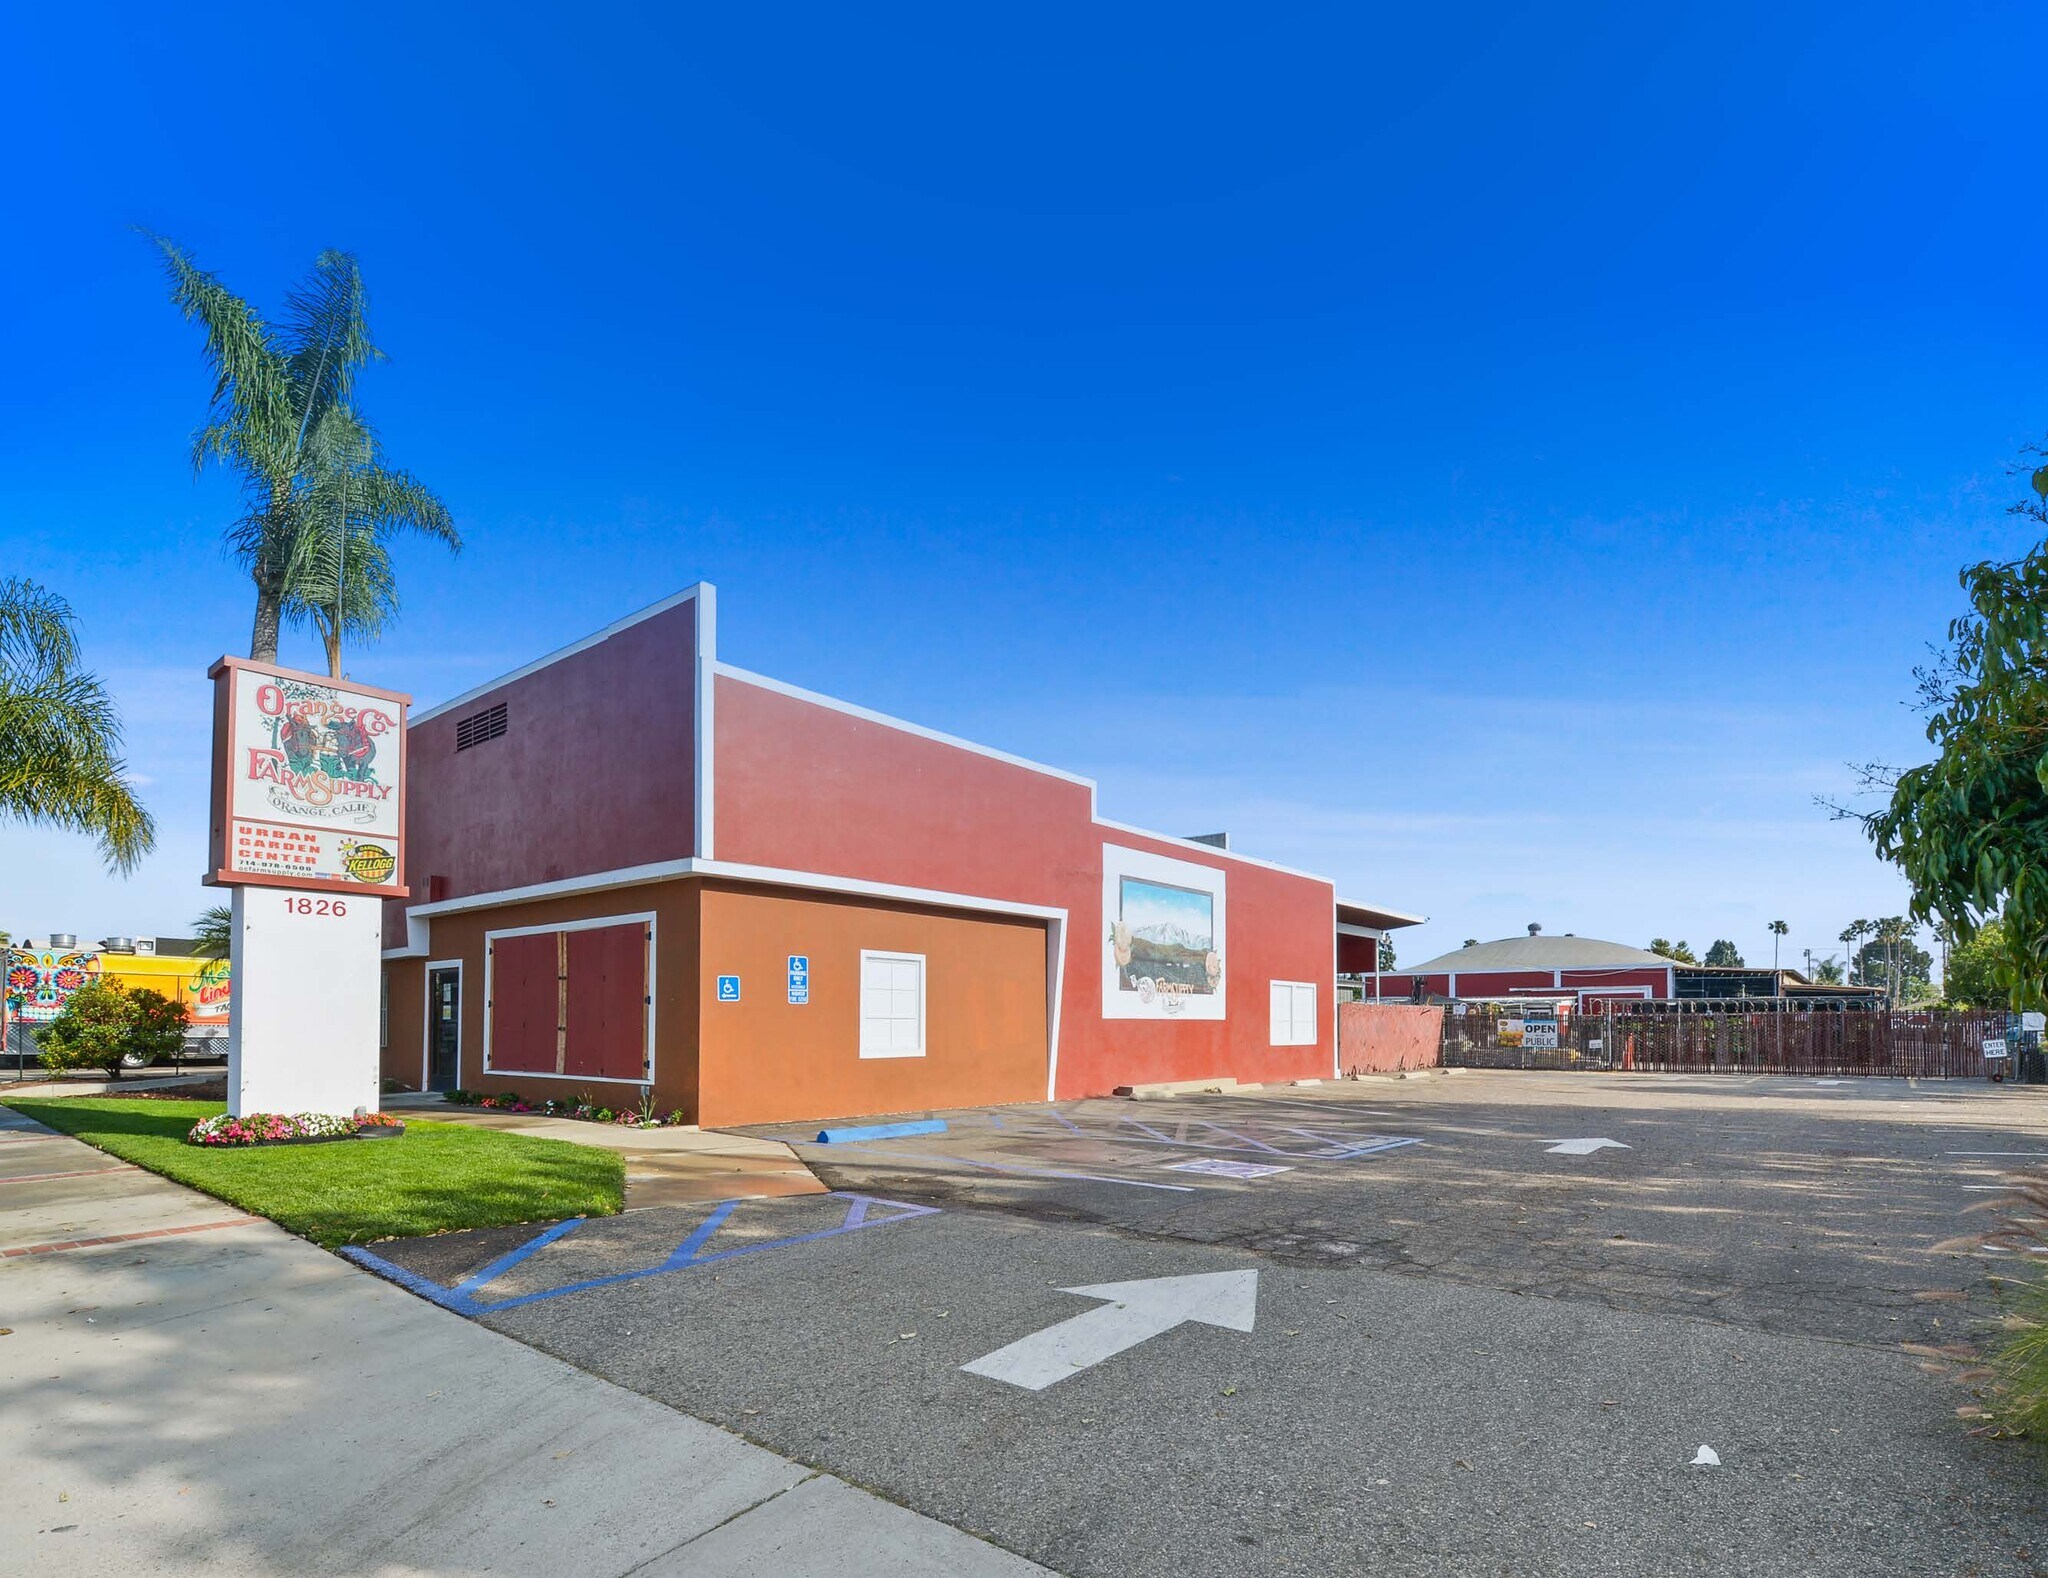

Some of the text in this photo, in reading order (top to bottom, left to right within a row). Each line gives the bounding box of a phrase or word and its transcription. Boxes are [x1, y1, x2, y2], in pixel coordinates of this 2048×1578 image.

[256, 684, 358, 726] Orange
[239, 826, 317, 842] URBAN
[239, 838, 320, 854] GARDEN
[238, 850, 317, 864] CENTER
[238, 866, 313, 877] ocfarmsupply.com
[348, 858, 394, 871] KELLOGG
[284, 897, 347, 917] 1826
[1525, 1025, 1556, 1033] OPEN
[1525, 1038, 1555, 1046] PUBLIC
